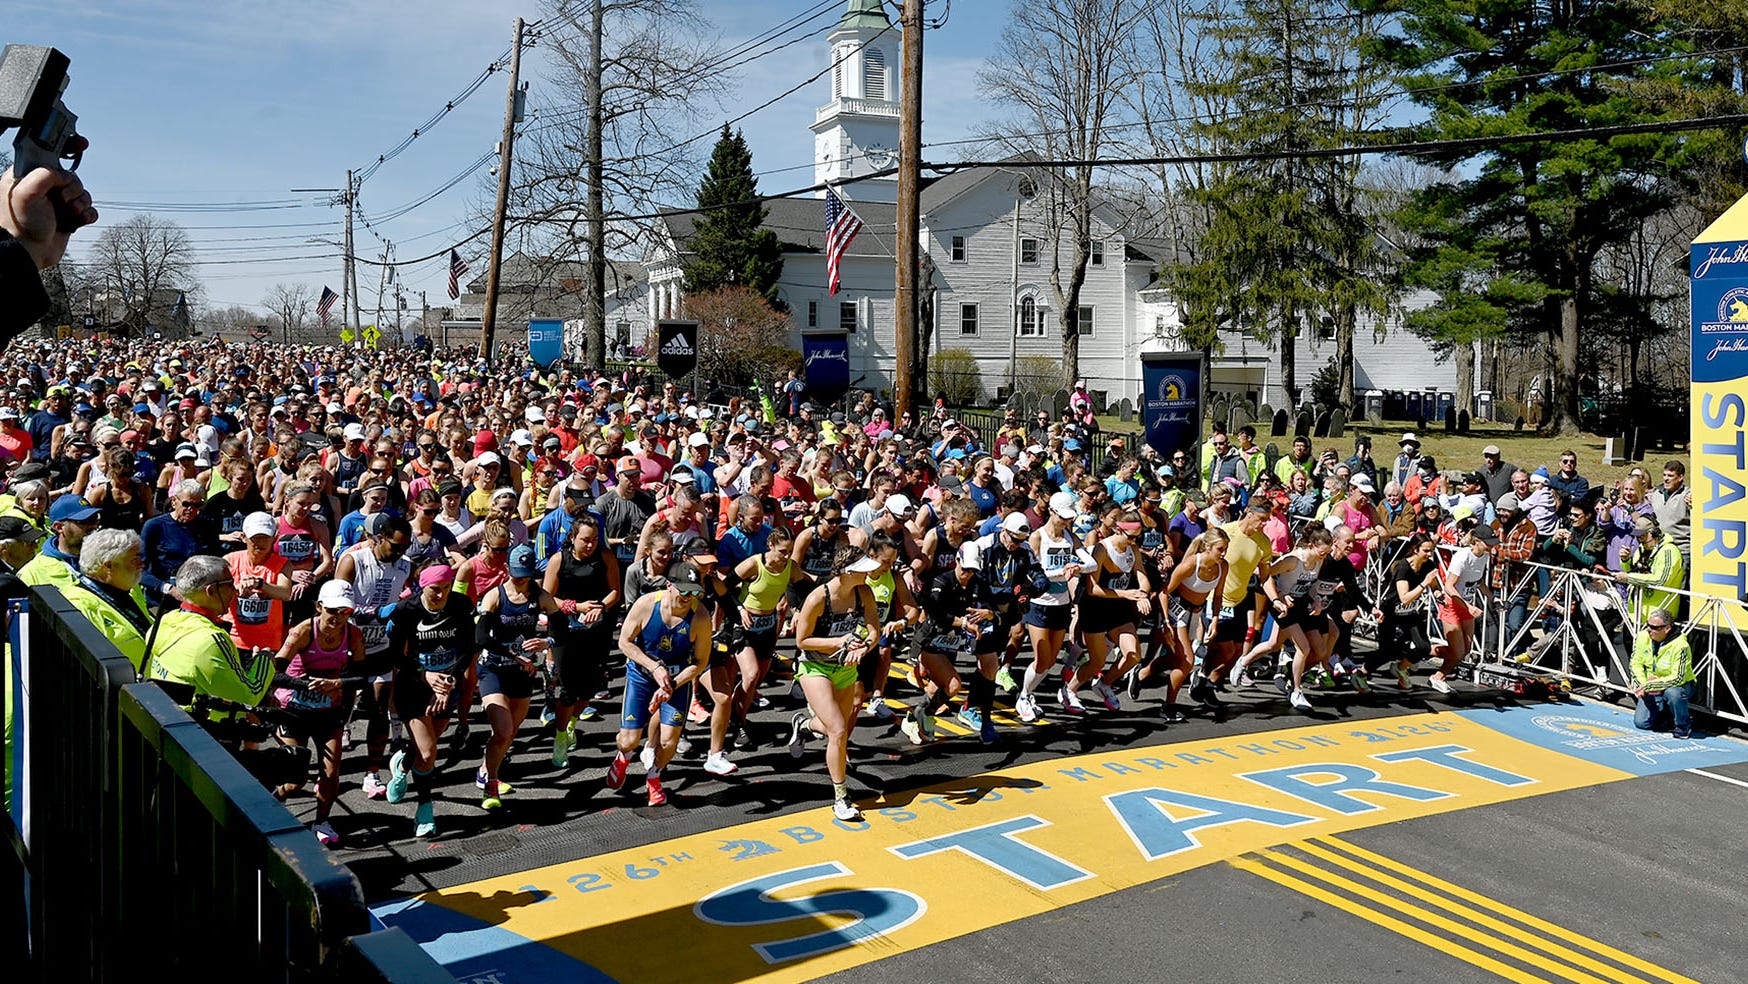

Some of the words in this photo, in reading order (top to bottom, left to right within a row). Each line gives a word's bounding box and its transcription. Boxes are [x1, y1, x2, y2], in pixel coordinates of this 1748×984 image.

[661, 347, 694, 355] adidas
[1702, 393, 1746, 600] START
[693, 744, 1541, 965] START
[778, 778, 1052, 845] BOSTON
[1056, 734, 1341, 782] MARATHON
